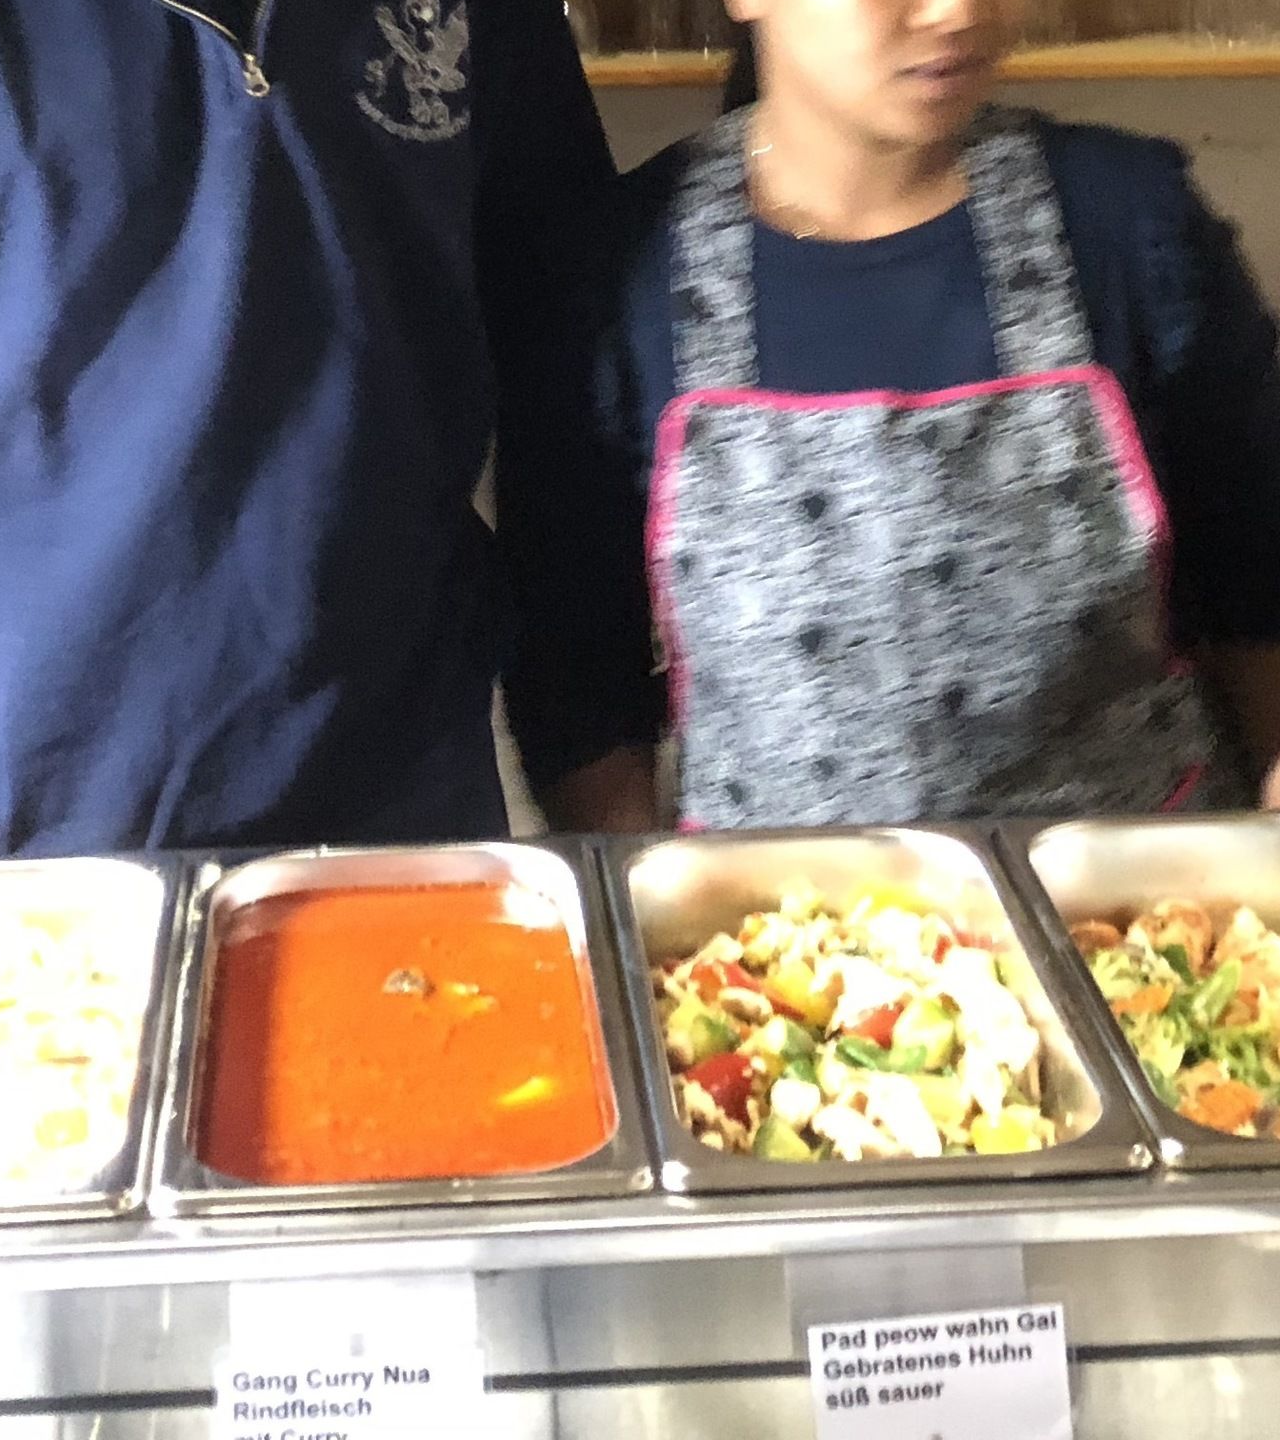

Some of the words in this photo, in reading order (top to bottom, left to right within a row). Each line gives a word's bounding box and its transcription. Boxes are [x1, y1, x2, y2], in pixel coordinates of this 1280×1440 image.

[821, 1329, 867, 1351] Pad
[875, 1324, 939, 1350] peow
[945, 1316, 1010, 1339] wahn
[823, 1353, 962, 1380] Gebratenes
[969, 1343, 1033, 1367] Huhn
[232, 1371, 298, 1395] Gang
[306, 1368, 374, 1392] Curry
[383, 1365, 431, 1385] Nua
[825, 1386, 870, 1410] süß
[878, 1380, 945, 1406] sauer
[233, 1397, 373, 1422] Rindfleisch
